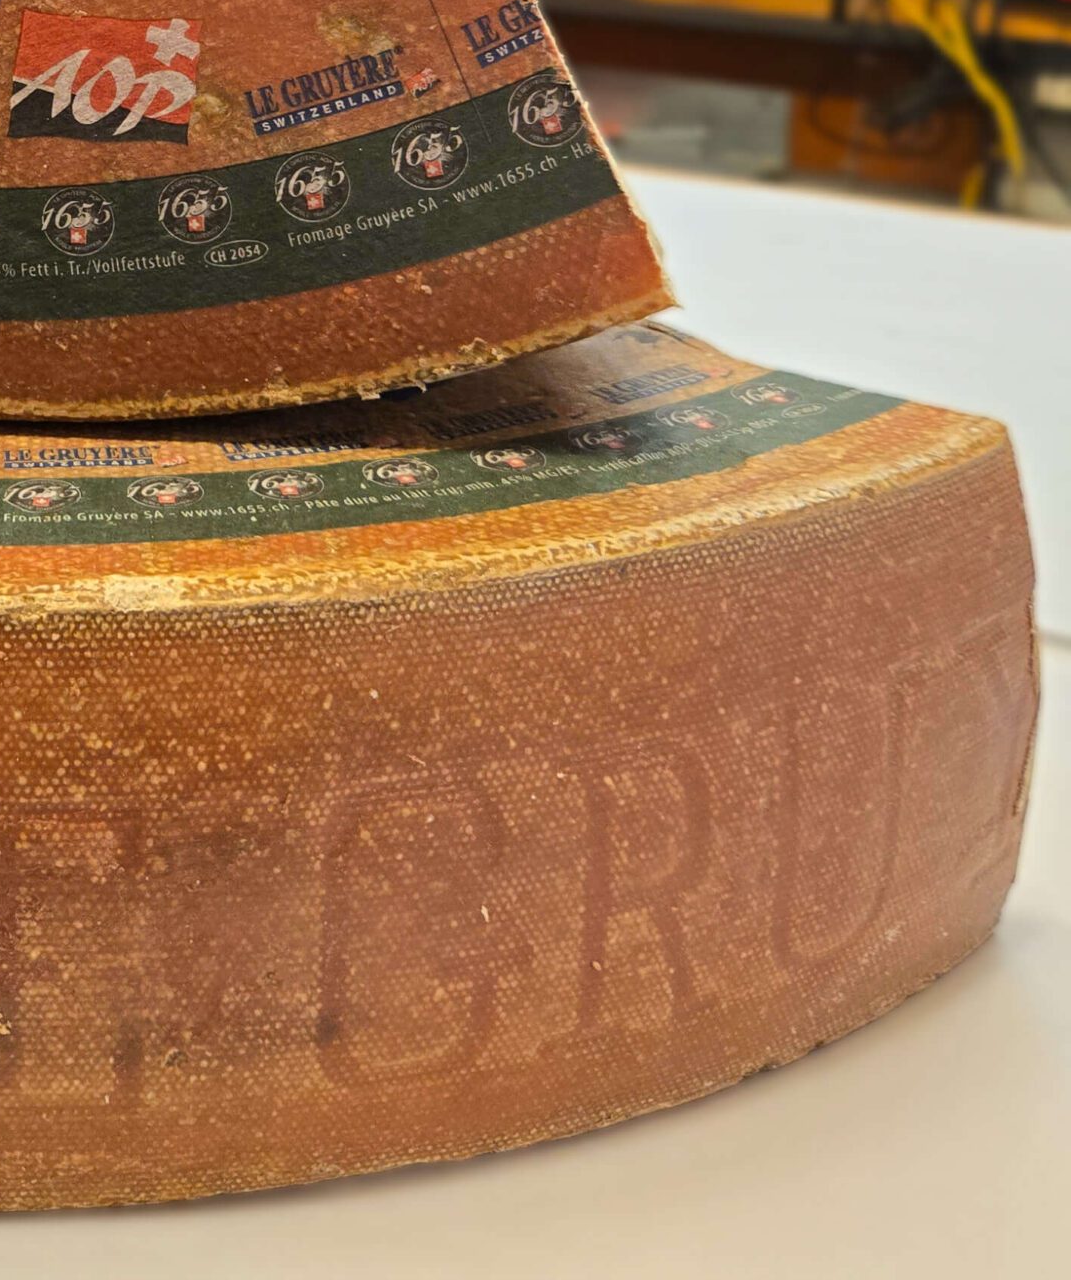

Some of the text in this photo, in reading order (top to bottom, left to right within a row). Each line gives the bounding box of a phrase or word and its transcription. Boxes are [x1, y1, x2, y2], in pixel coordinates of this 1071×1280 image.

[460, 14, 500, 53] LE
[10, 49, 197, 137] AOP
[243, 86, 274, 120] LE
[260, 83, 399, 134] SWITZERLAND
[392, 124, 463, 174] 1655
[275, 160, 346, 203] 1655
[287, 141, 597, 249] Fromage Gruyère SA www.1655.ch Ha
[40, 199, 114, 232] 1655
[157, 185, 230, 222] 1655
[20, 261, 51, 278] Fett
[53, 262, 65, 278] i.
[209, 243, 262, 265] CH 2054
[3, 449, 31, 462] LE
[3, 512, 72, 525] Fromage
[76, 508, 140, 523] Gruyère
[143, 508, 165, 520] SA
[180, 502, 291, 519] www.1655.ch
[304, 498, 340, 512] Pâte
[343, 493, 379, 507] dure
[382, 492, 402, 503] au
[403, 487, 431, 500] lait
[464, 478, 499, 493] min.
